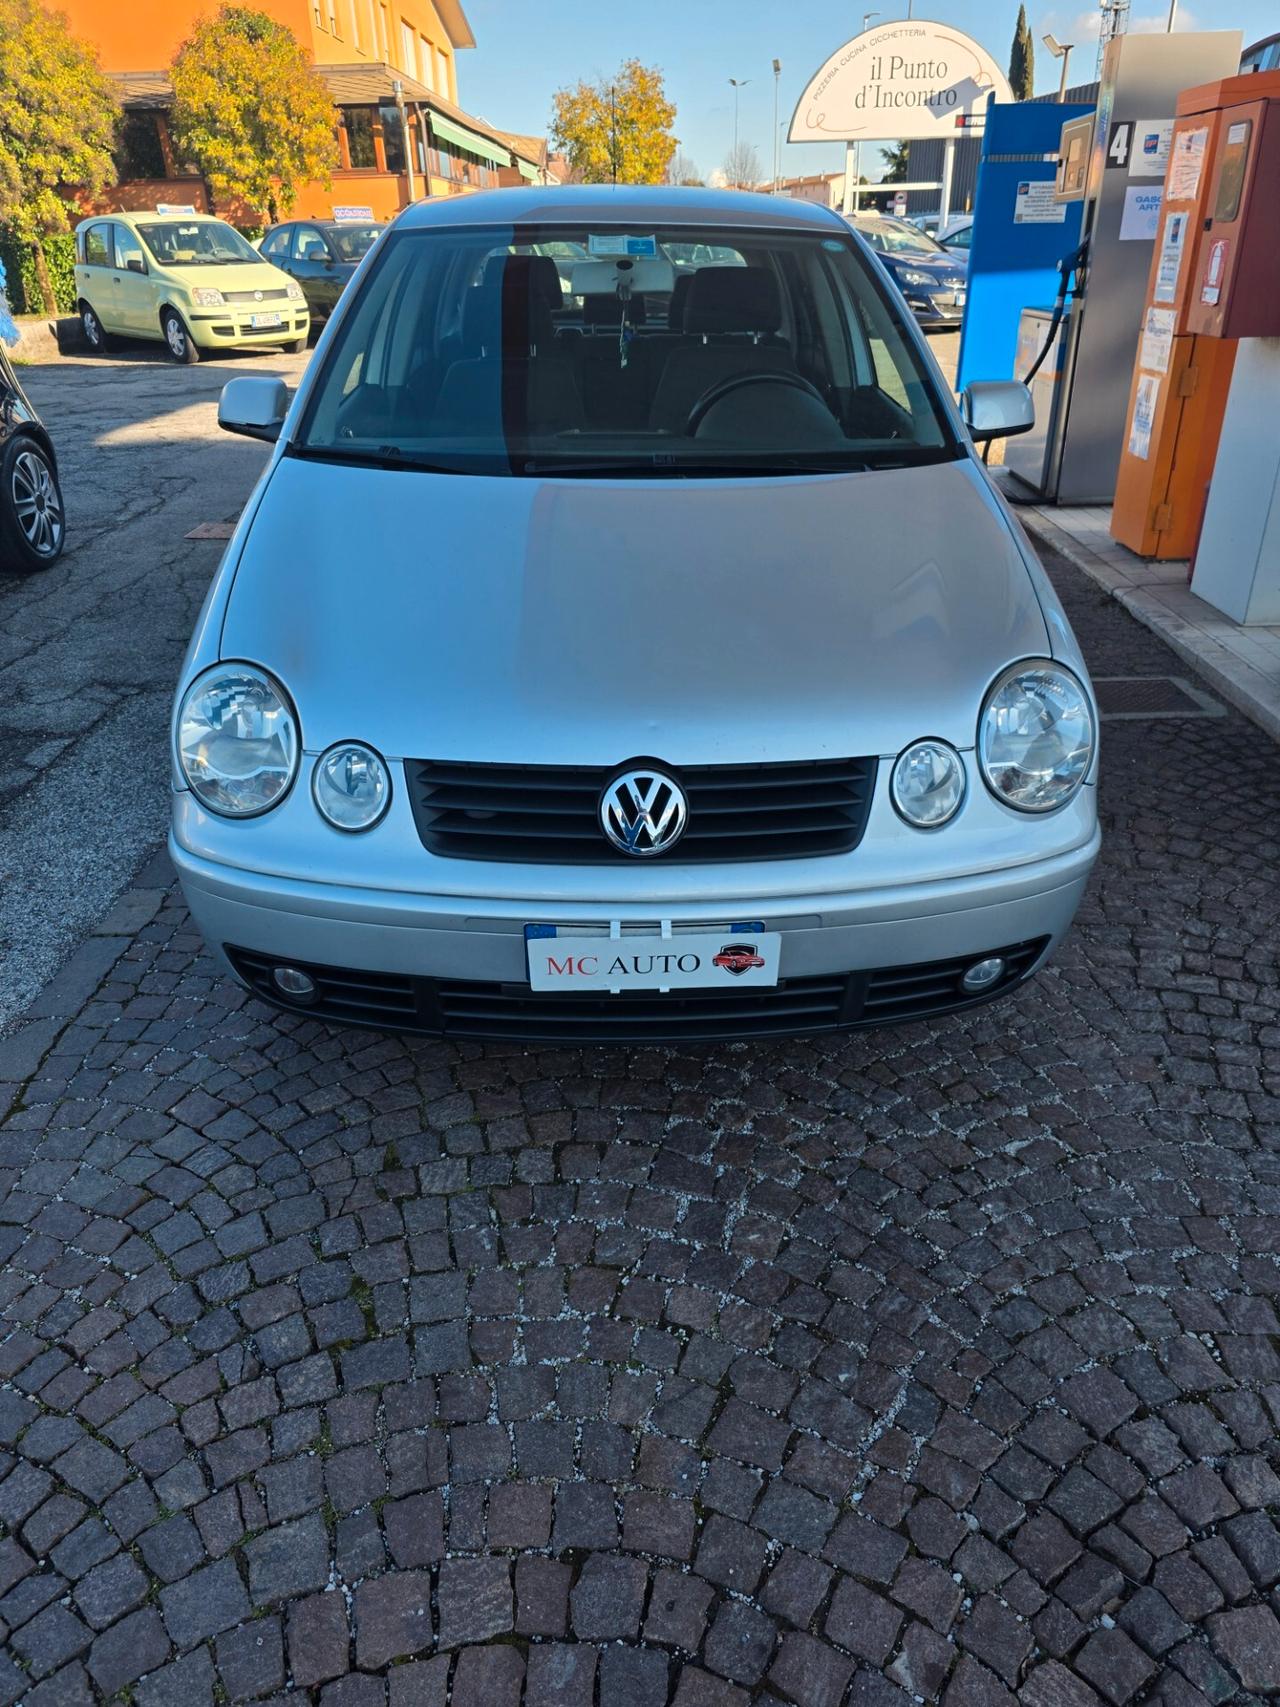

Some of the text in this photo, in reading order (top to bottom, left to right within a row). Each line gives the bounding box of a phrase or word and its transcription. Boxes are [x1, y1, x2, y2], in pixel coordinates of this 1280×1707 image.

[812, 29, 926, 101] PIZZERIA CUCINA CICCHETTERIA
[870, 56, 948, 80] il Punto
[855, 85, 957, 109] d'Incontro
[1109, 124, 1129, 165] 4
[546, 953, 701, 976] MC AUTO
